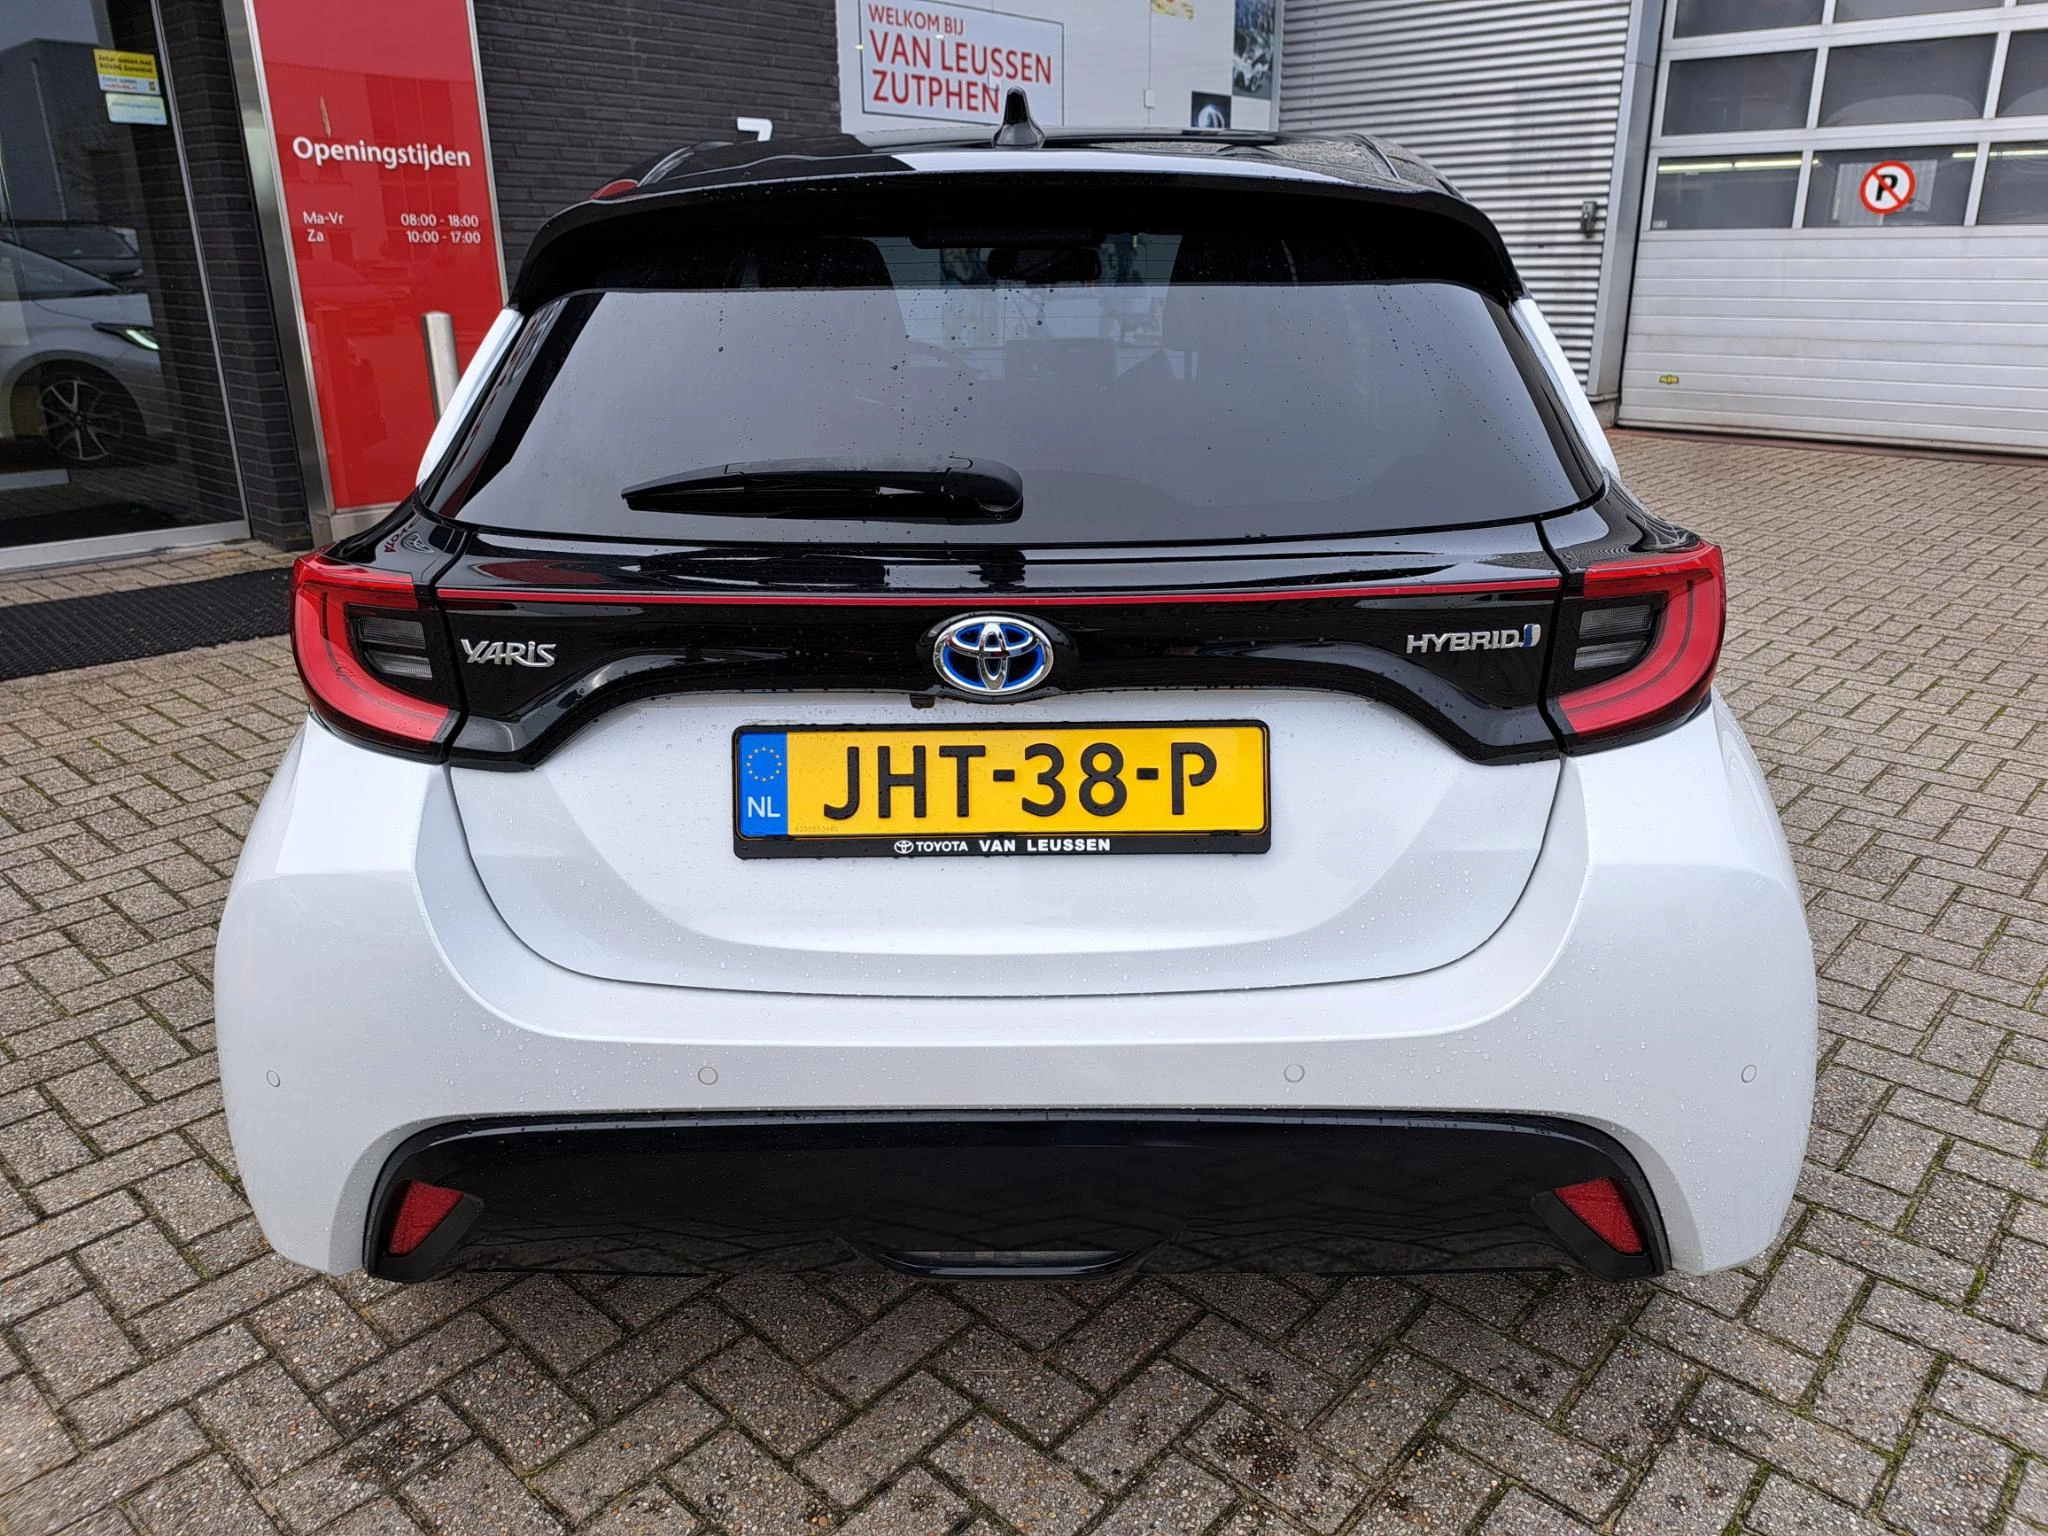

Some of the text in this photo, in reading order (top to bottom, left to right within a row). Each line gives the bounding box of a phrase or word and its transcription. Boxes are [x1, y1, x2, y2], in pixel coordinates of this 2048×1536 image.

[868, 4, 964, 36] WELKOM BIJ
[869, 29, 1052, 85] VAN LEUSSEN
[872, 69, 999, 114] ZUTPHEN
[292, 136, 471, 171] Openingstijden
[303, 210, 345, 225] Ma-Vr
[400, 213, 437, 227] 08:00
[448, 214, 480, 228] 18:00
[306, 228, 326, 243] Za
[406, 230, 440, 243] 10:00
[450, 230, 482, 244] 17:00
[460, 638, 557, 668] YARIS
[1405, 628, 1522, 654] HYBRID
[822, 741, 1218, 821] JHT-38-P
[746, 795, 782, 818] NL
[915, 838, 1111, 852] TOYOTA VAN LEUSSEN
